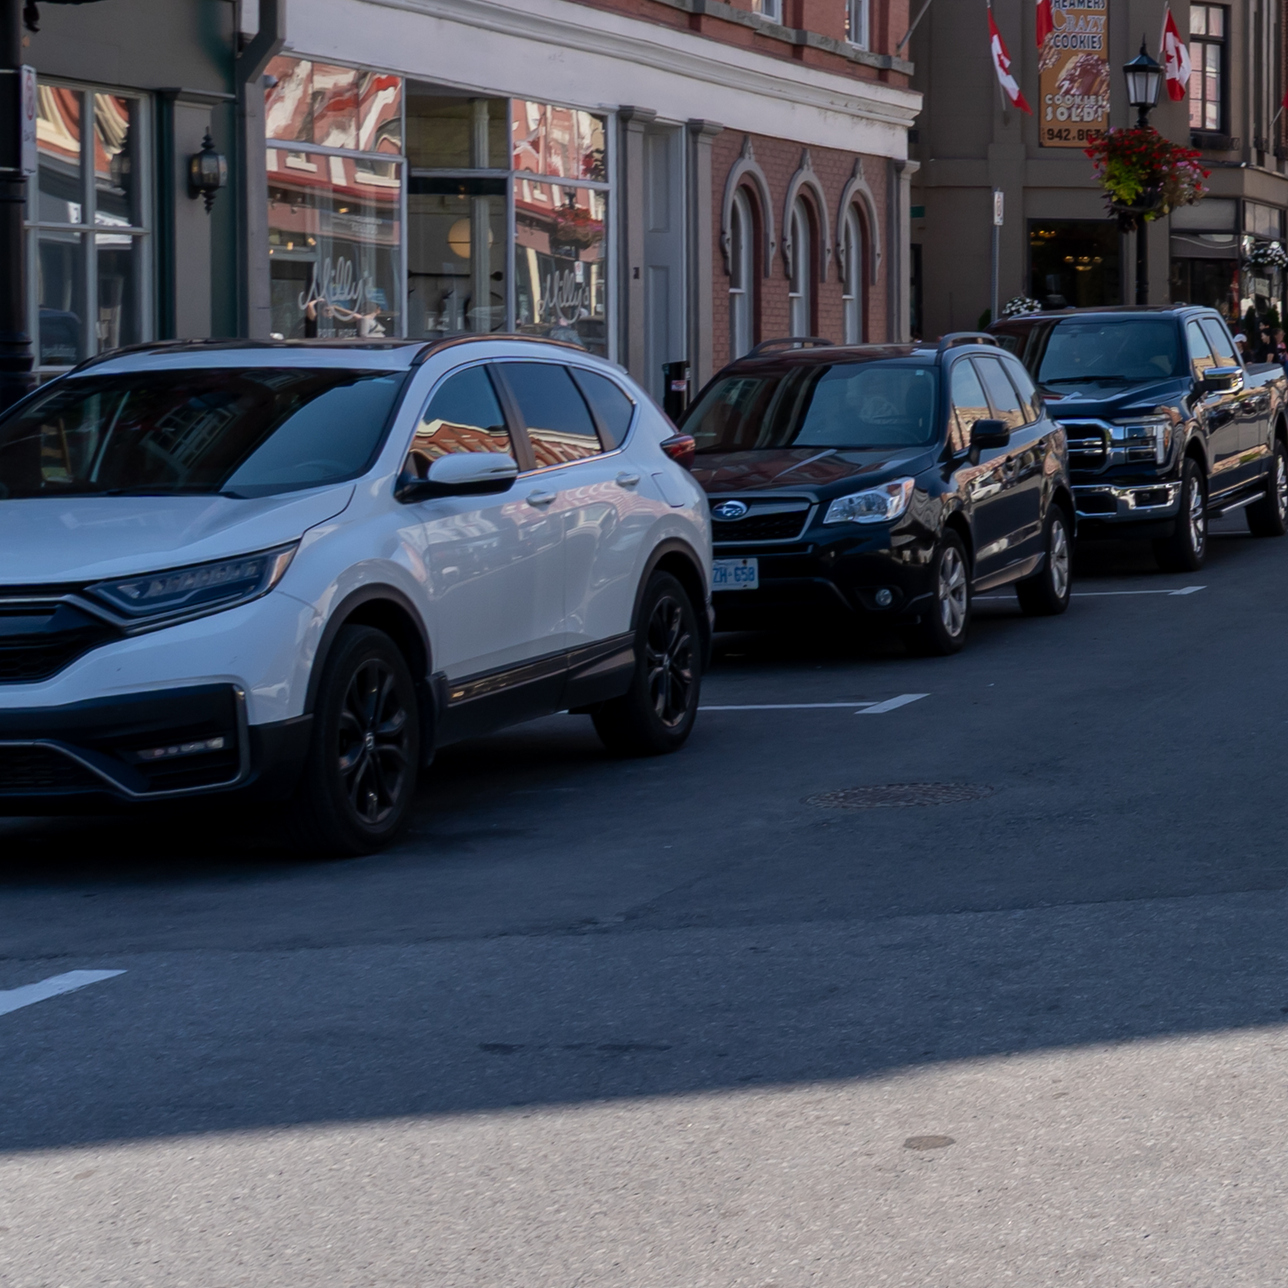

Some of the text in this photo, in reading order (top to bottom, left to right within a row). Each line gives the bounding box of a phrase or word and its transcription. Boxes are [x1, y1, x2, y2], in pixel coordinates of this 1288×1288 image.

[1053, 34, 1103, 50] COOKIES
[1045, 94, 1103, 105] COOKIES
[1045, 106, 1104, 122] SOLD!
